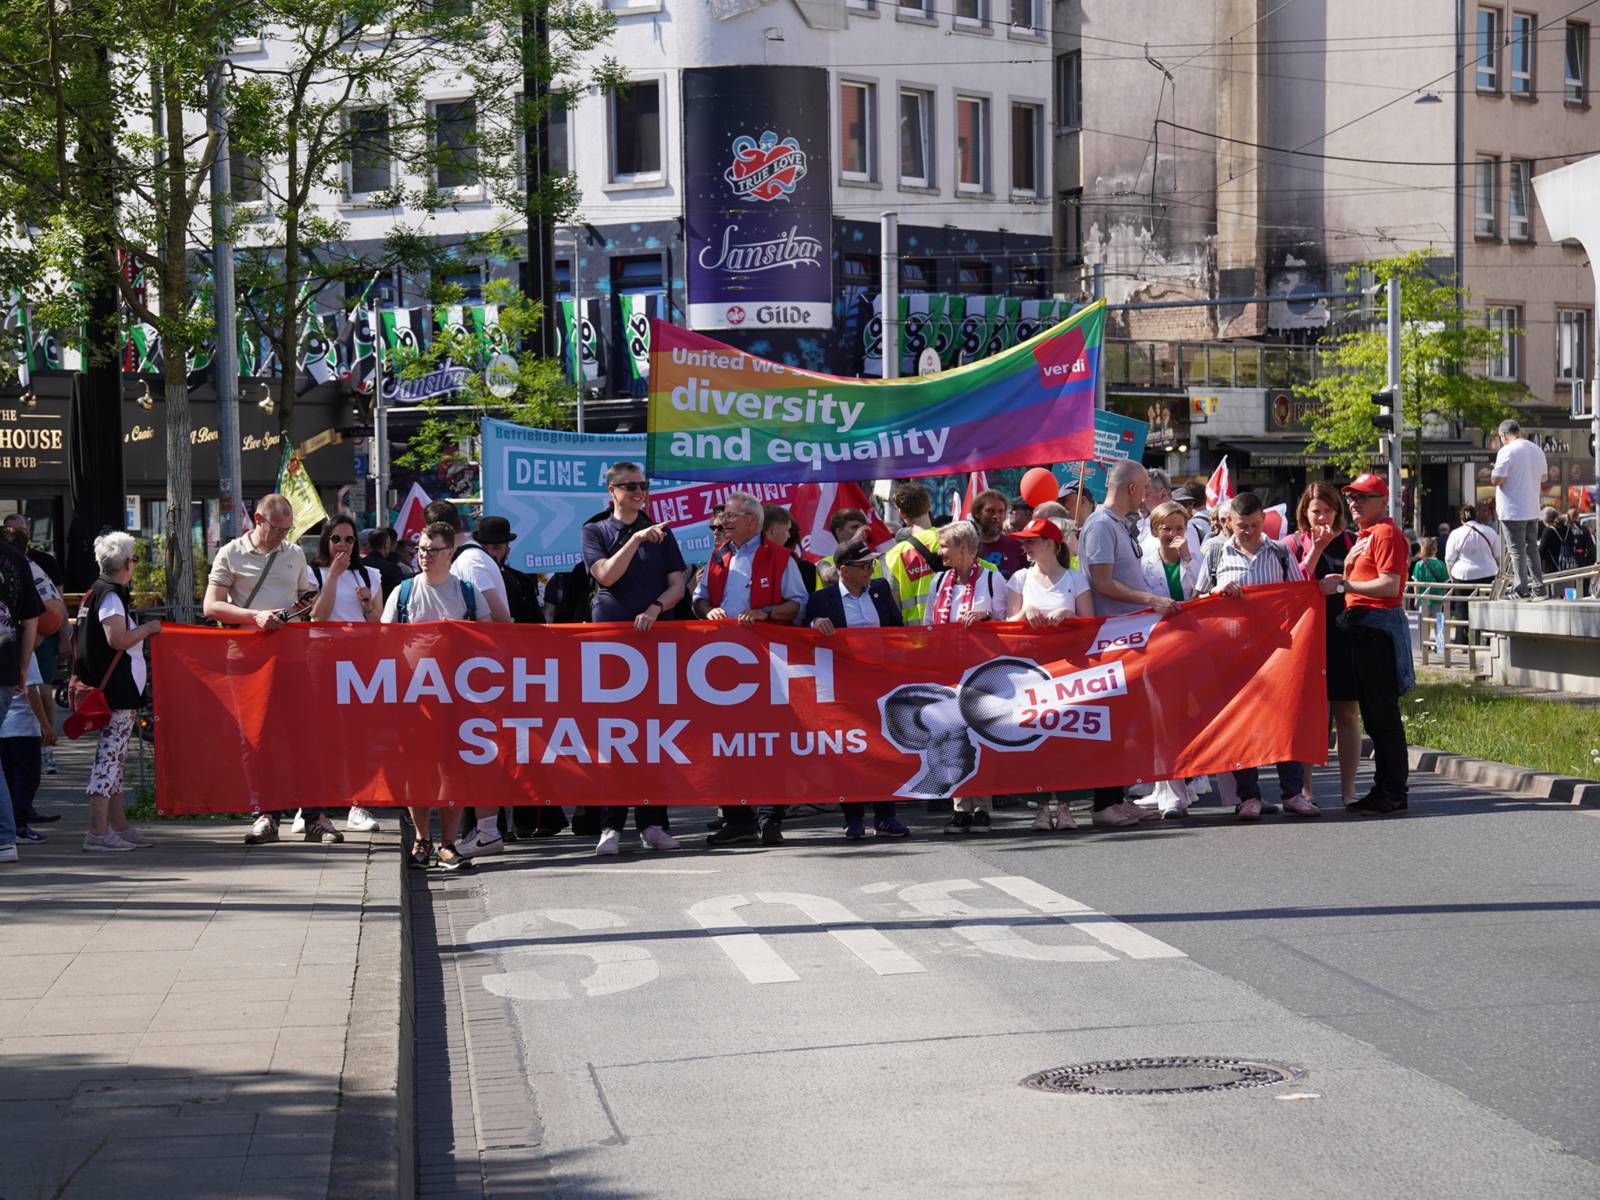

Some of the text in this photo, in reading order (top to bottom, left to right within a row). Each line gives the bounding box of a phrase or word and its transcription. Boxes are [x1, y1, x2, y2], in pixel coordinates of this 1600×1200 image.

[738, 153, 802, 192] TRUE LOVE
[699, 225, 823, 271] Sansibar
[756, 305, 811, 324] Gilde
[672, 347, 785, 374] United we
[671, 378, 865, 432] diversity
[0, 429, 63, 449] HOUSE
[670, 426, 950, 471] and equality
[15, 457, 37, 468] PUB
[516, 458, 587, 487] DEINE
[653, 495, 693, 524] INE
[687, 535, 711, 550] und
[526, 552, 582, 567] Gemeins
[1097, 631, 1144, 650] DGB
[335, 641, 835, 706] MACH DICH
[1024, 668, 1118, 706] 1. Mai
[1019, 708, 1102, 734] 2025
[458, 717, 868, 765] STARK MIT UNS
